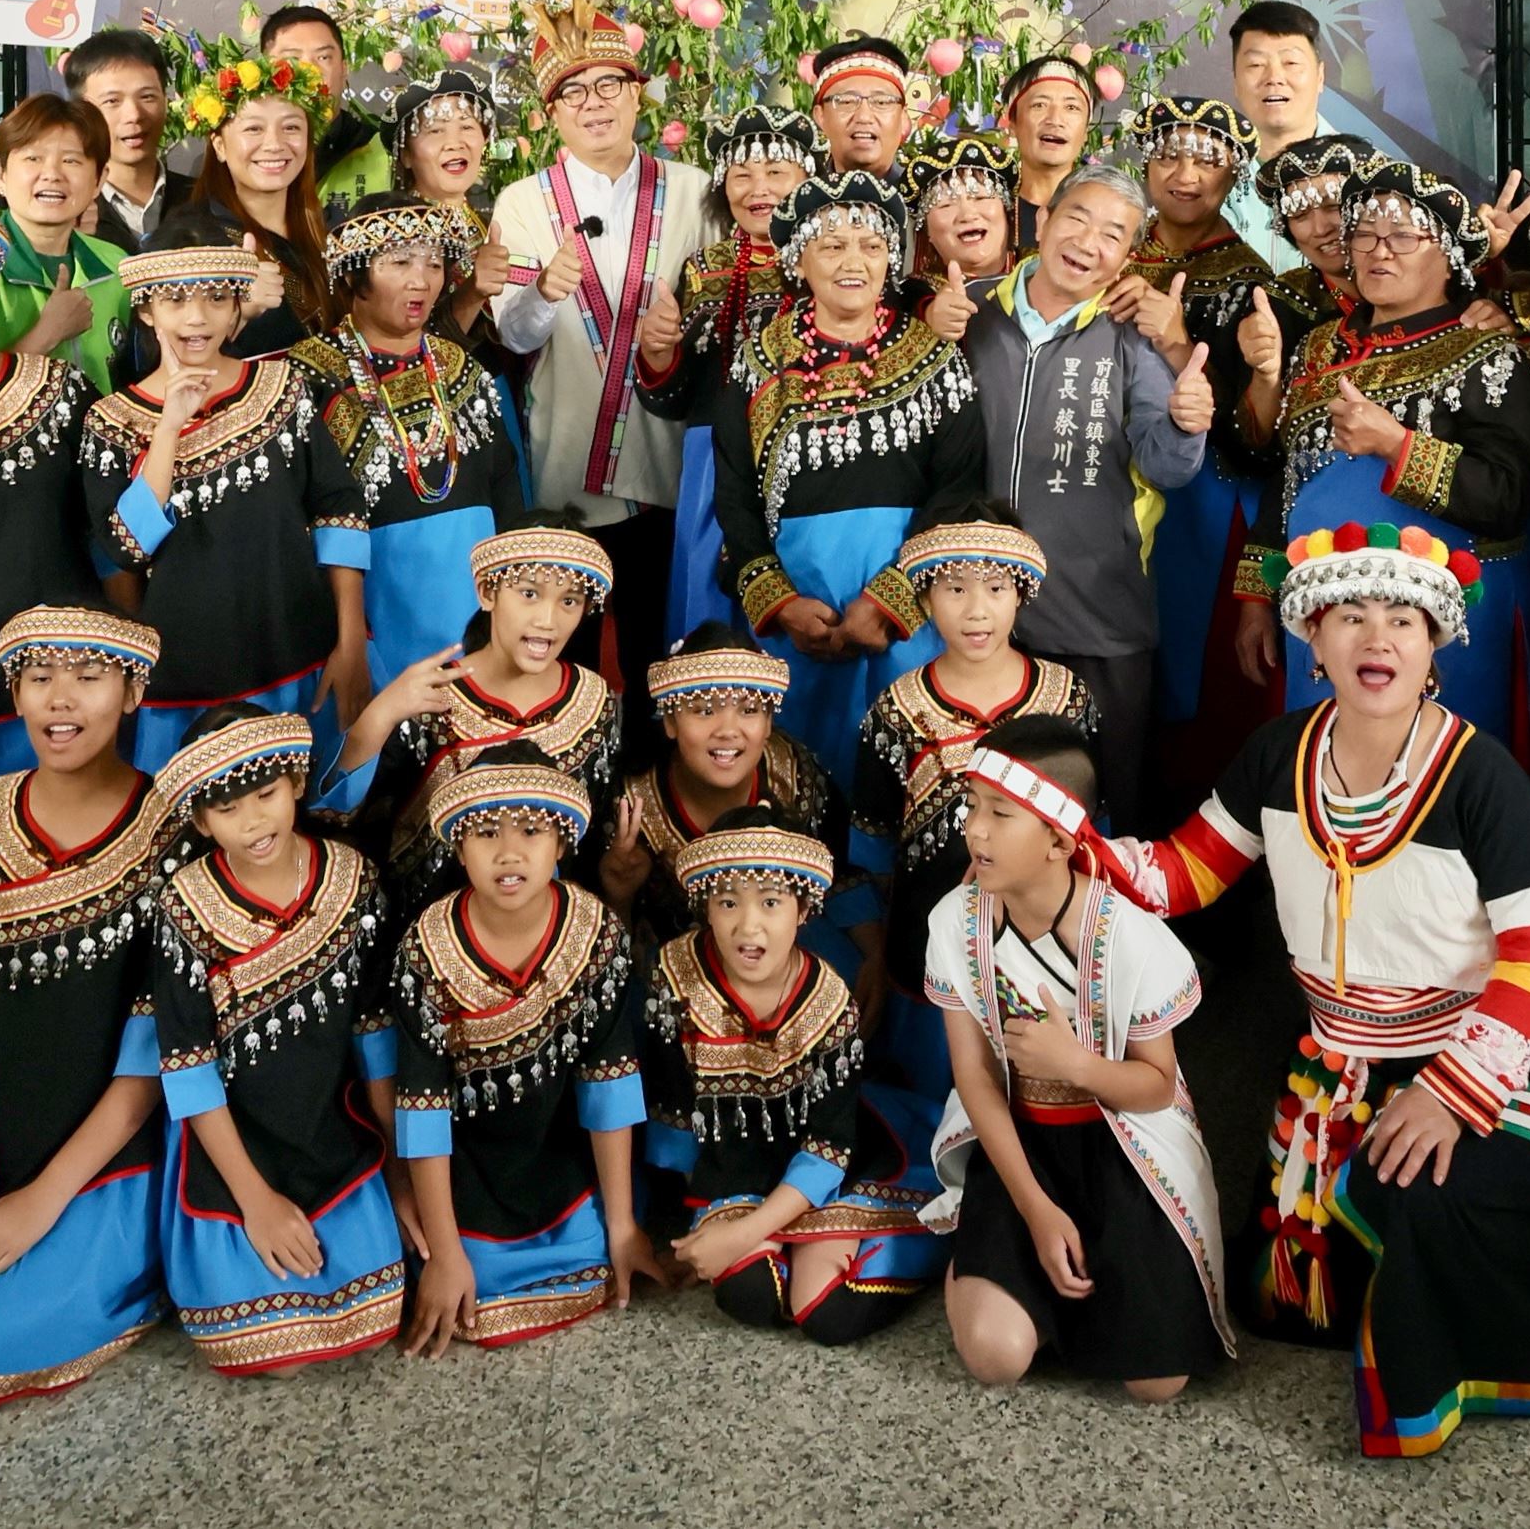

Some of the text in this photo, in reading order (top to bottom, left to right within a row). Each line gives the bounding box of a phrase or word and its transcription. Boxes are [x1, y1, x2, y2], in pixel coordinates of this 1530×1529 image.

[1082, 357, 1114, 487] 前鎮區鎮東里
